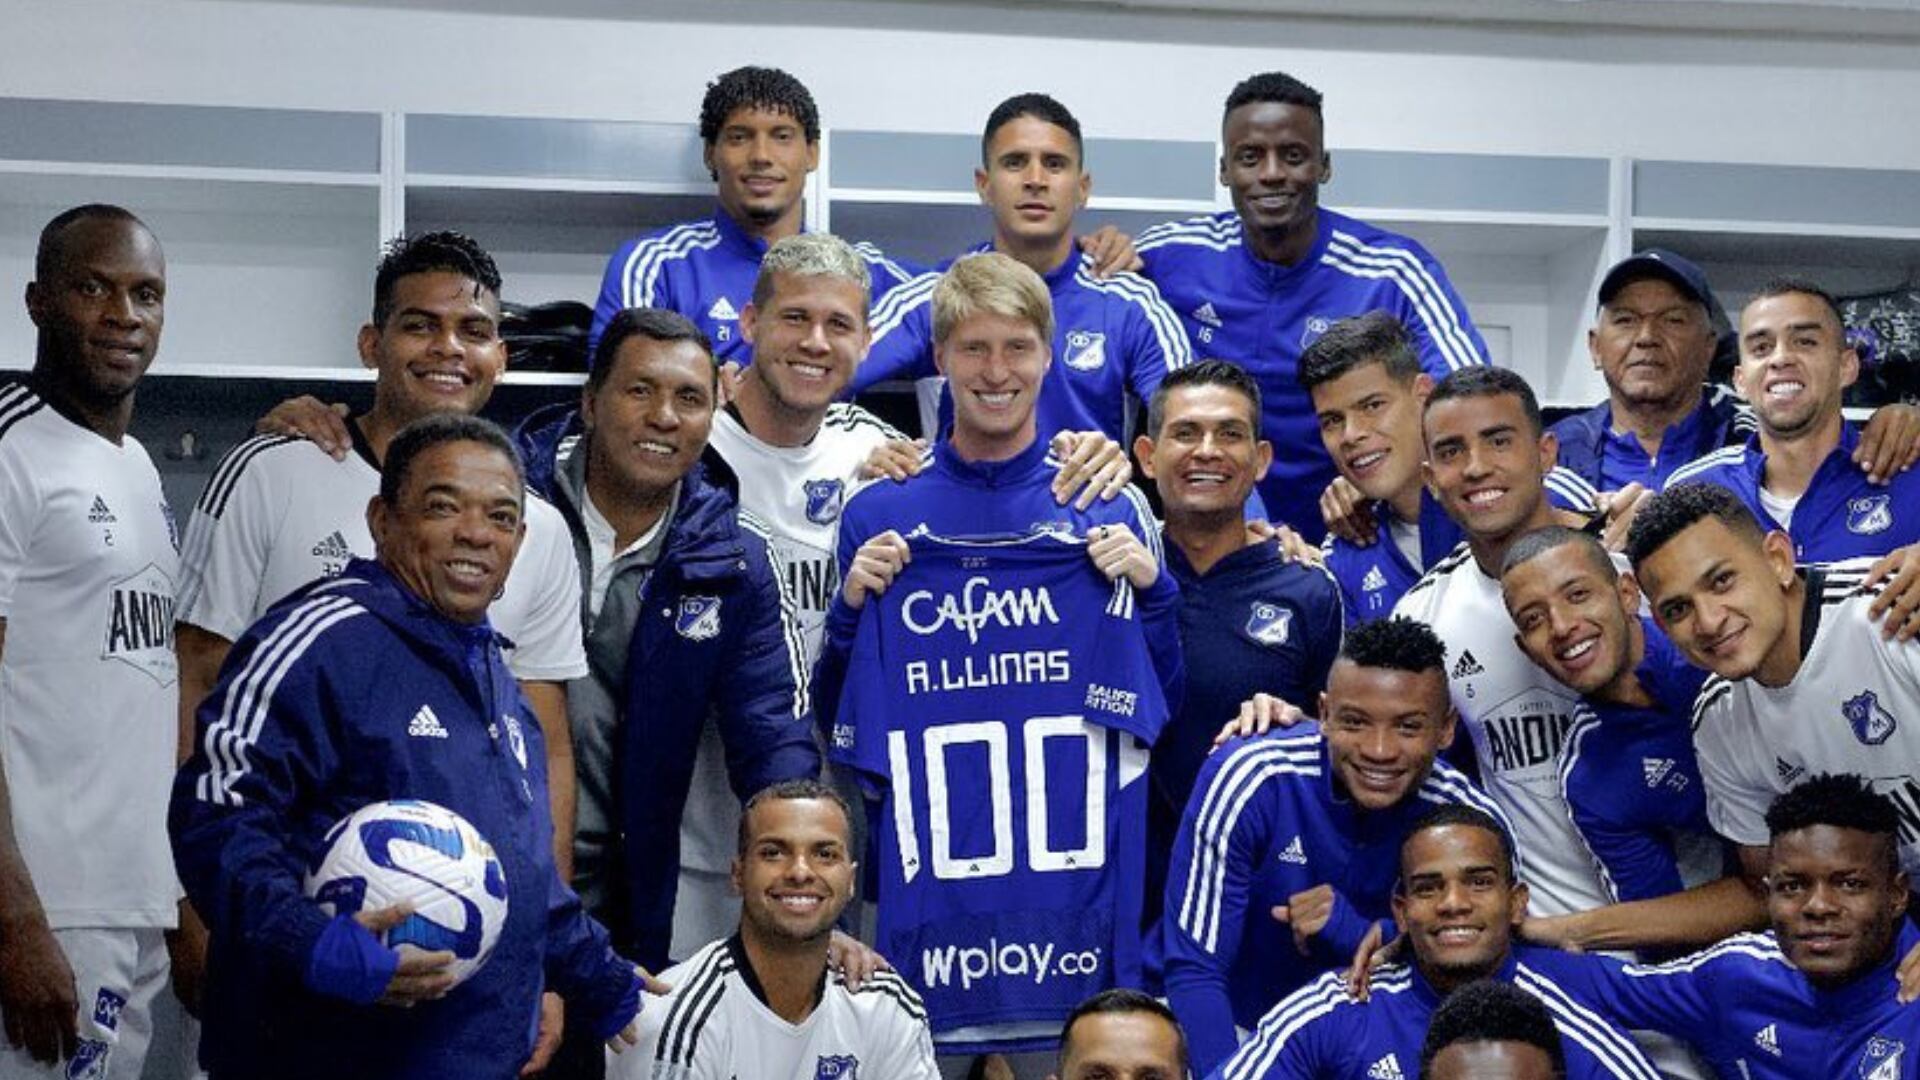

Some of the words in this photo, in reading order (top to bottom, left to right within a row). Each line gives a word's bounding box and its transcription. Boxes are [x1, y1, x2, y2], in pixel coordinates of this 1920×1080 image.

[906, 650, 1070, 695] A.LLINAS
[888, 715, 1107, 884] 100
[923, 937, 1099, 990] wplay.co
